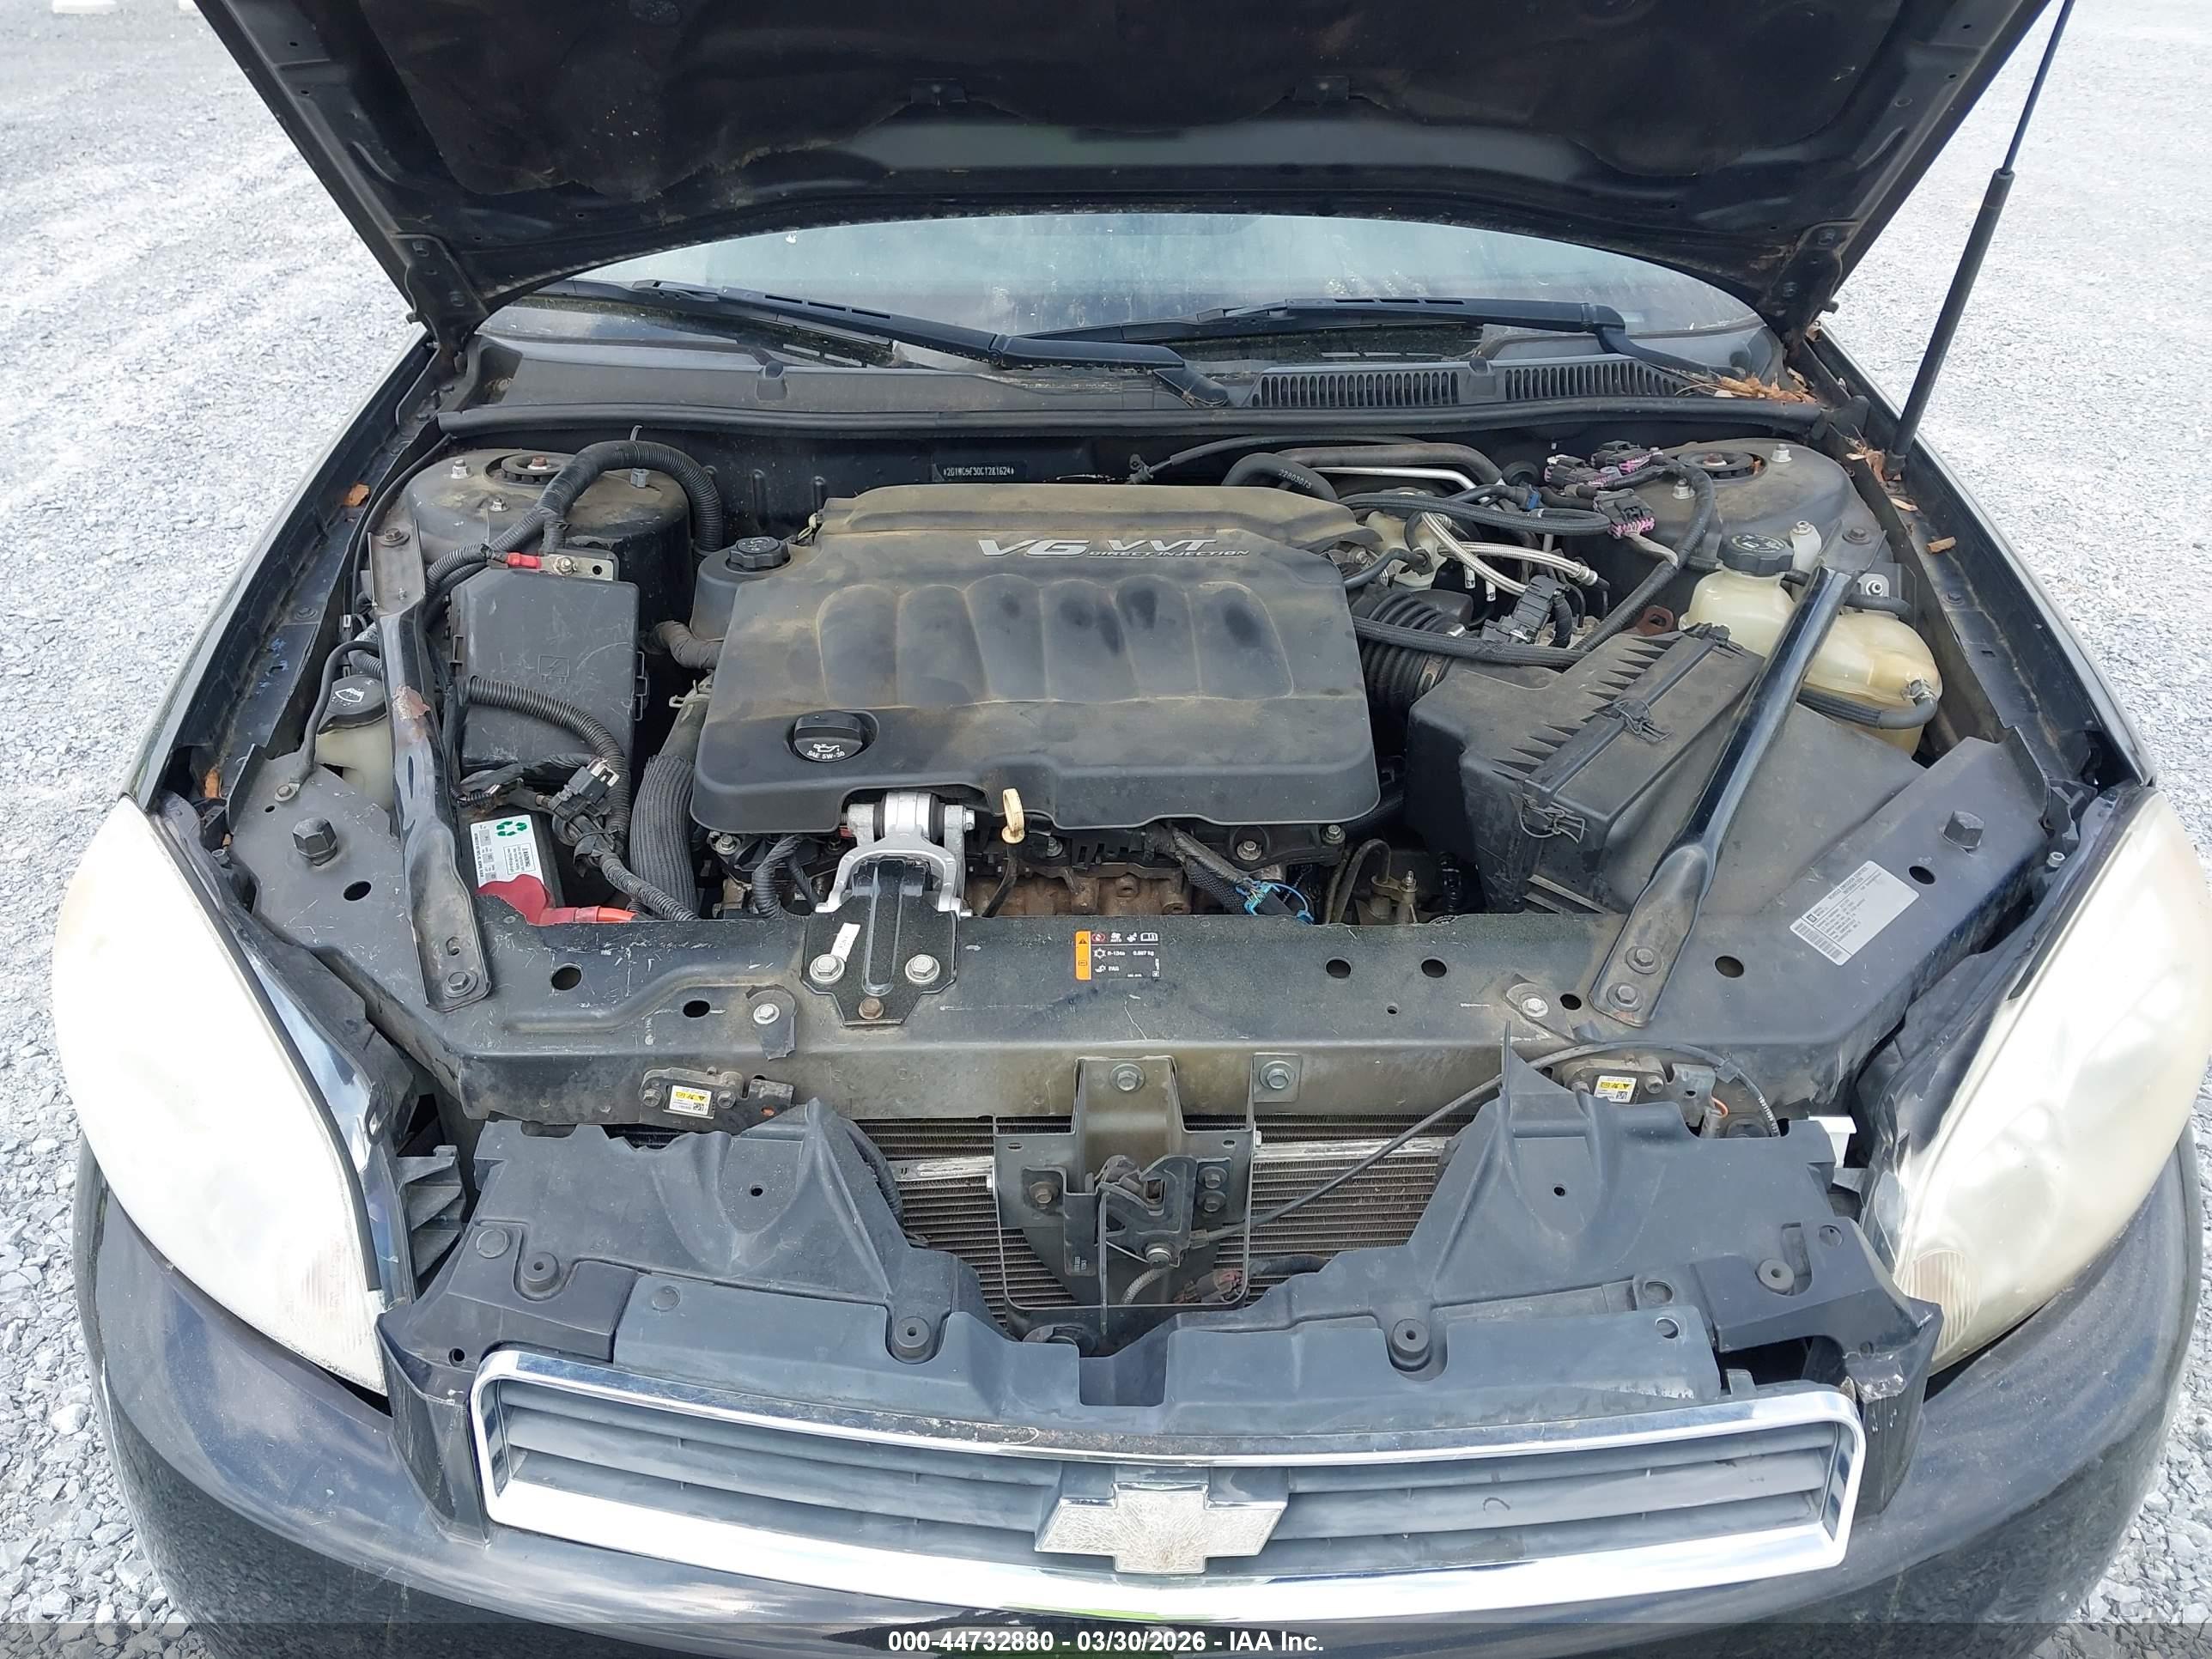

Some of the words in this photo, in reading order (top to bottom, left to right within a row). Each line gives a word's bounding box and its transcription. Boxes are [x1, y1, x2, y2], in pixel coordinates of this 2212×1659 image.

[977, 539, 1091, 556] V6
[1108, 539, 1218, 551] VVT
[807, 750, 820, 759] SAE
[822, 750, 846, 760] 5W-30
